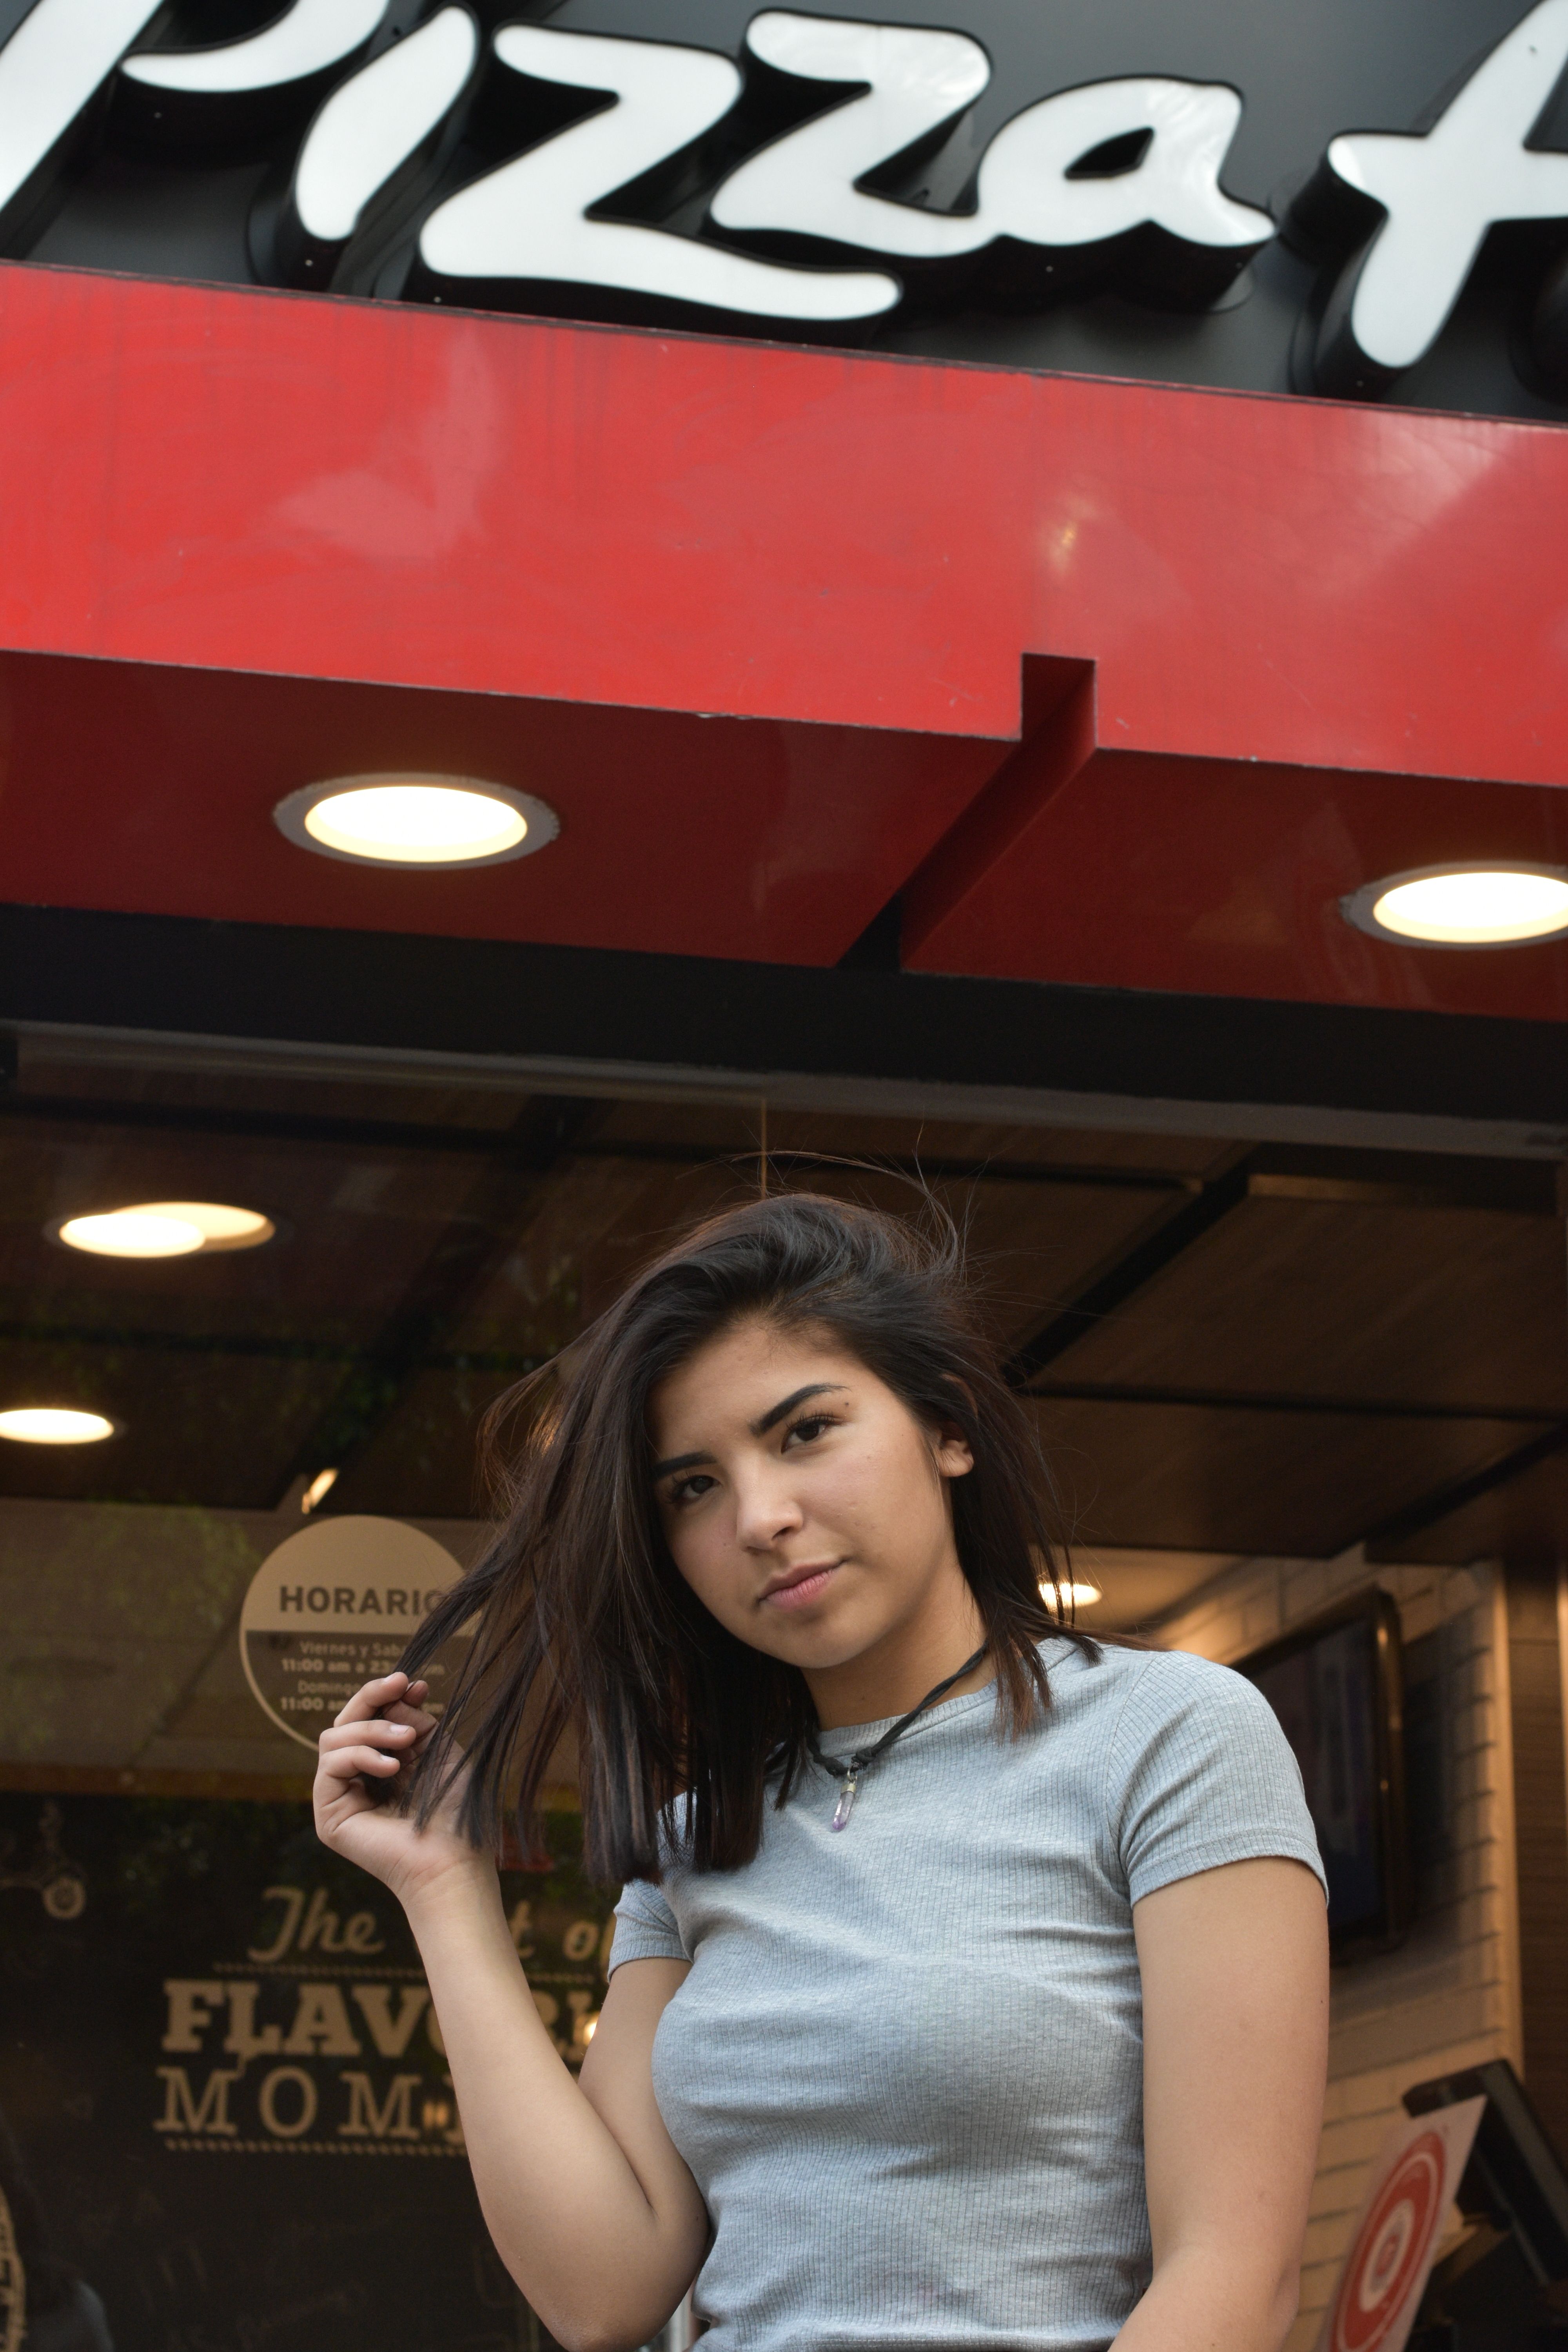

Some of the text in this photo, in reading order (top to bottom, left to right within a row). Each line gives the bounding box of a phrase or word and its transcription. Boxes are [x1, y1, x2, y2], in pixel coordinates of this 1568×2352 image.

[281, 1658, 324, 1672] 11:00
[327, 1662, 351, 1673] am
[281, 1697, 324, 1711] 11:00
[247, 1886, 385, 1963] The
